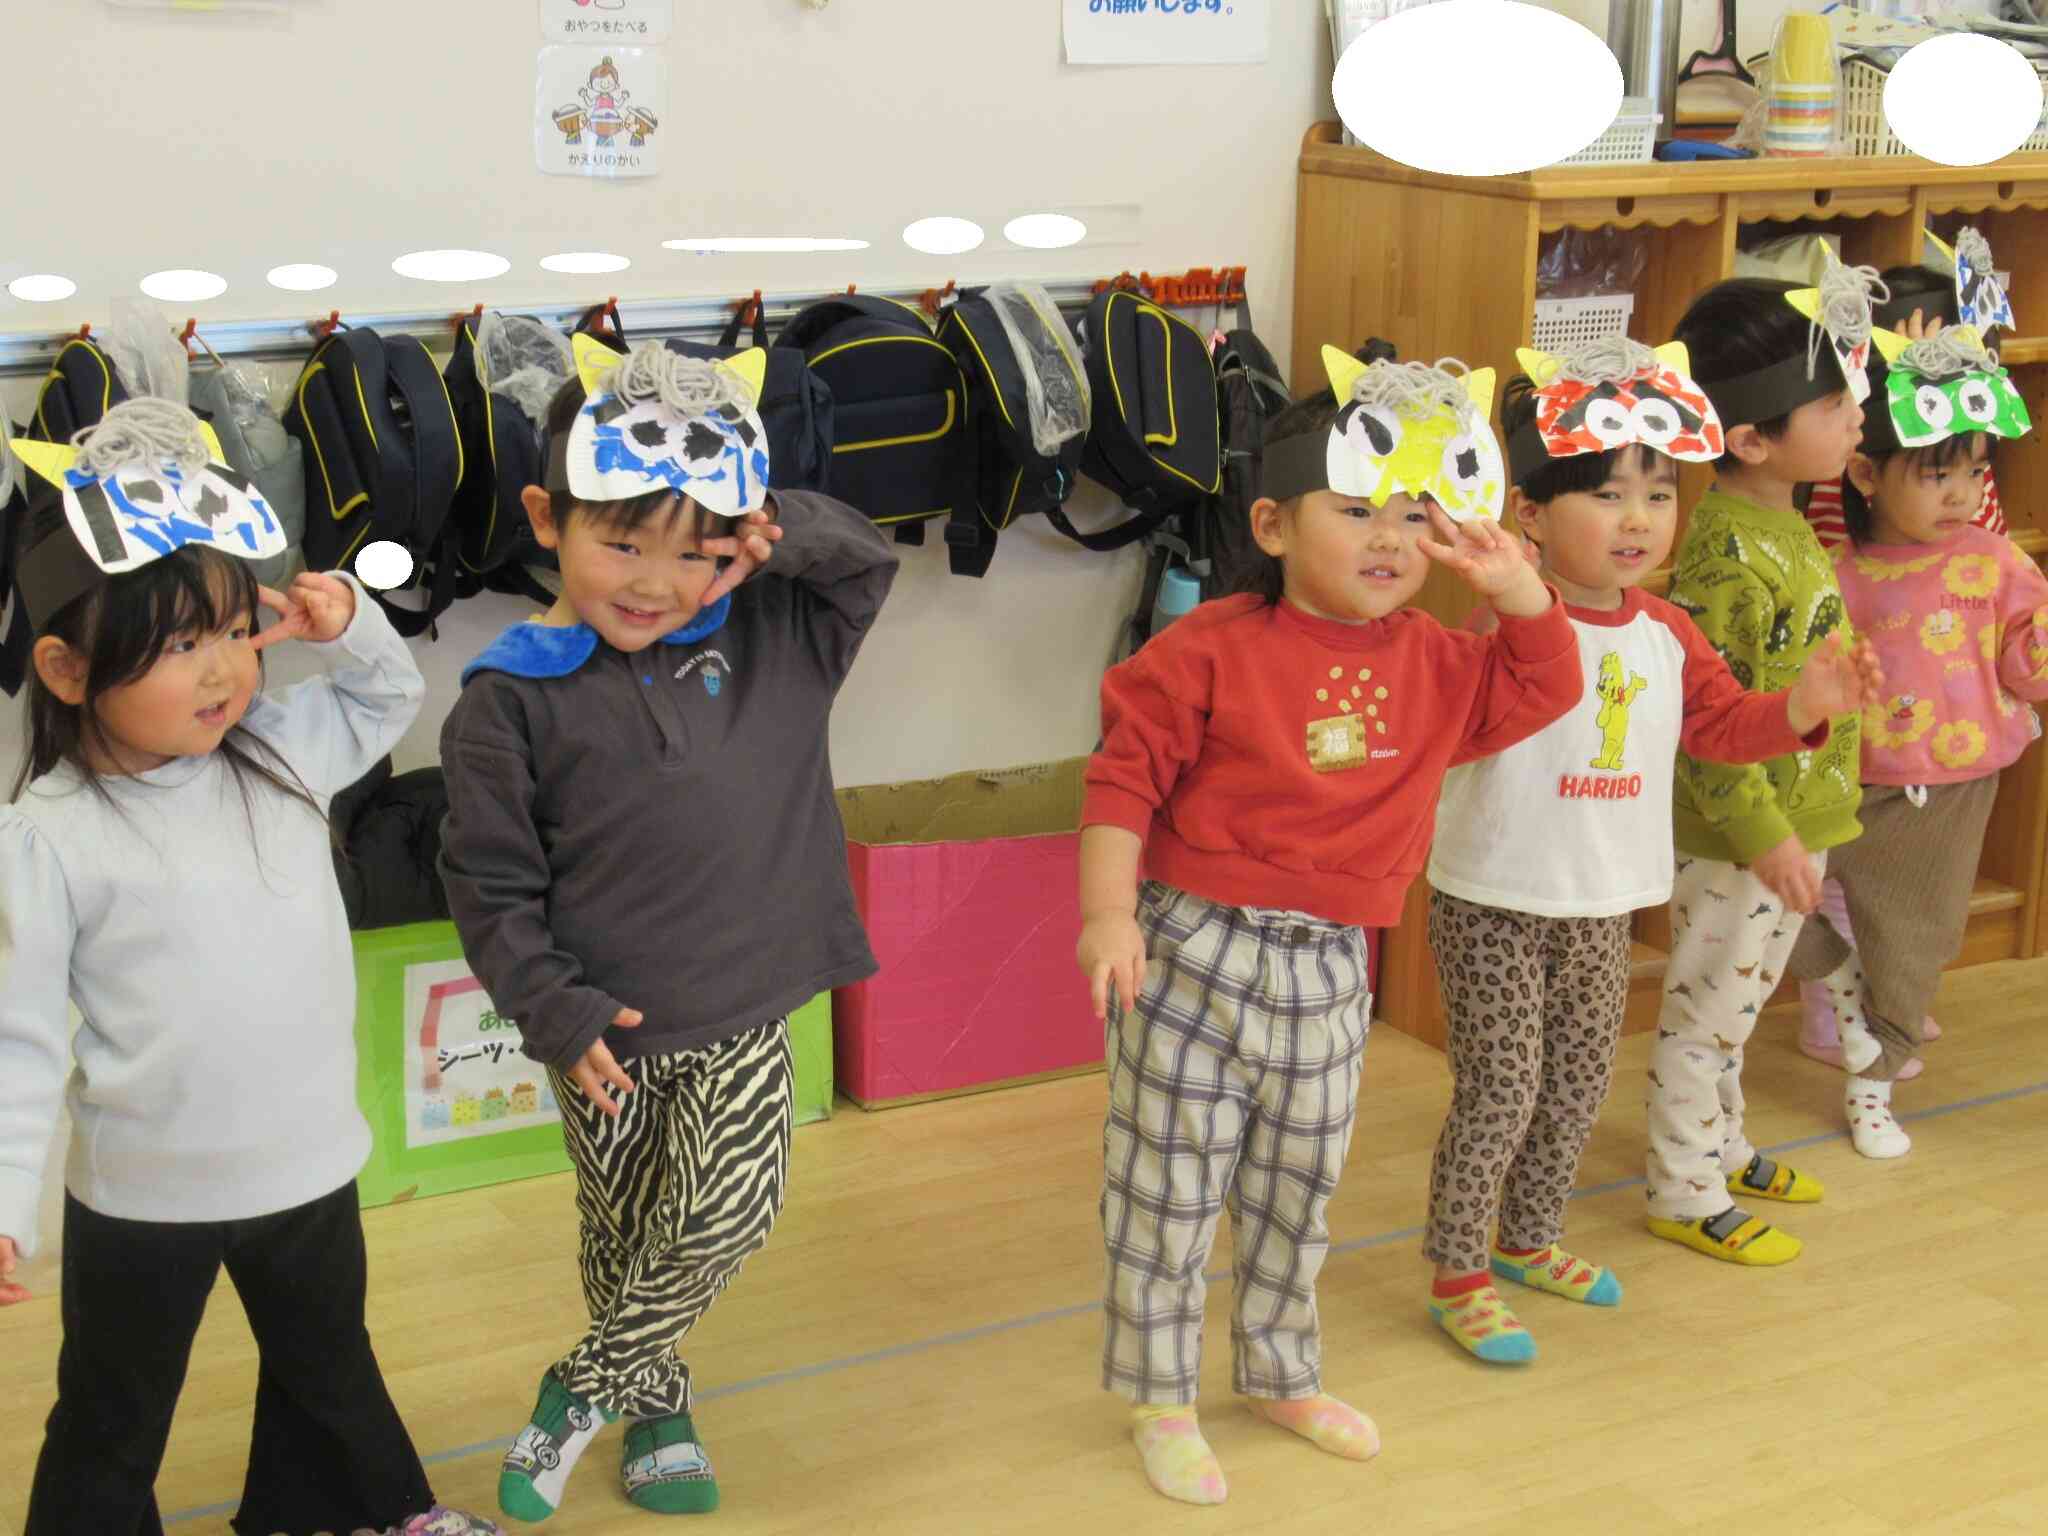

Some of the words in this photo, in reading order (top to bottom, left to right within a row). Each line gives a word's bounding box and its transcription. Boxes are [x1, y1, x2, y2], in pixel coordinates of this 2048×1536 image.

[564, 19, 648, 33] おやつをたべる
[568, 153, 640, 167] かえりのかい
[1558, 773, 1643, 800] HARIBO
[437, 1041, 523, 1073] シーツ・
